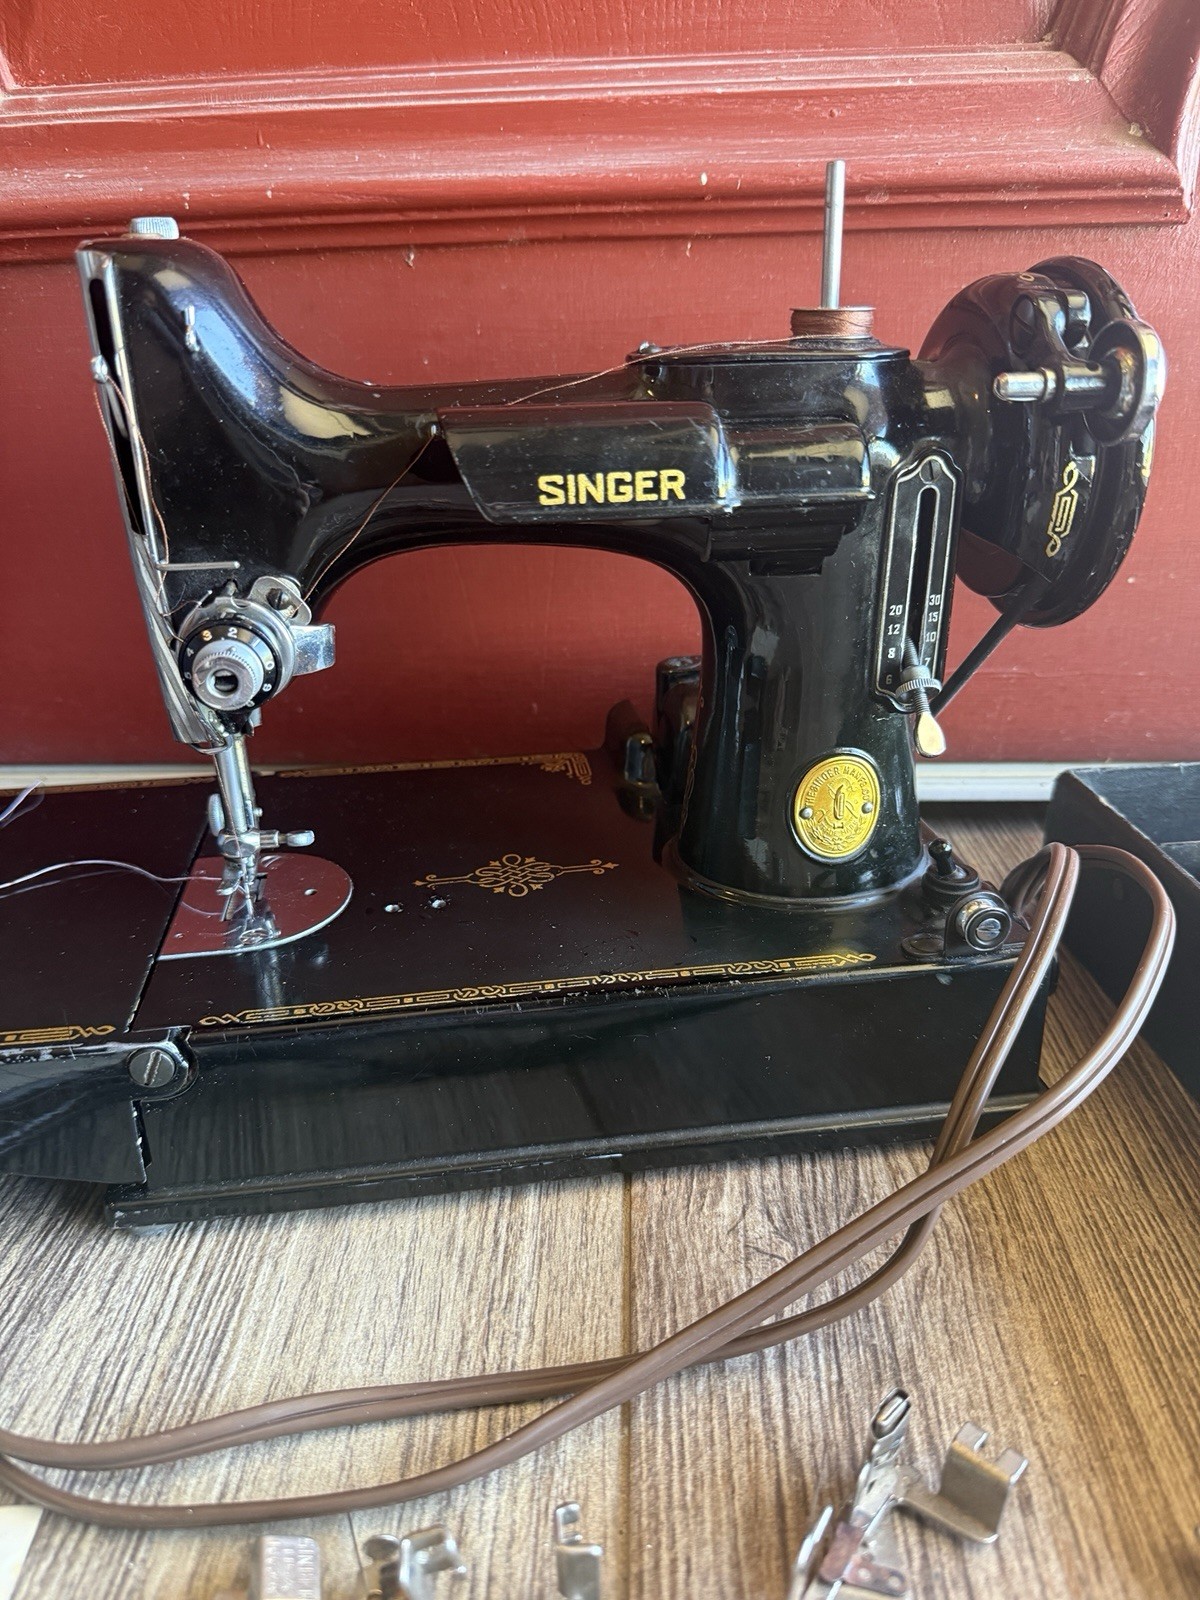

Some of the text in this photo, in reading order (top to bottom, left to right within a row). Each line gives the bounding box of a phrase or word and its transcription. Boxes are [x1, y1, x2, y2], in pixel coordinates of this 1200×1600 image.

[537, 468, 686, 506] SINGER
[928, 594, 941, 606] 30
[888, 604, 903, 616] 20
[927, 611, 939, 622] 15
[887, 623, 901, 635] 12
[925, 631, 937, 642] 10
[186, 647, 195, 657] 4
[202, 629, 213, 641] 3
[227, 626, 238, 639] 2
[264, 660, 275, 671] 0
[887, 647, 896, 659] 8
[924, 657, 931, 667] 7
[885, 674, 893, 685] 6
